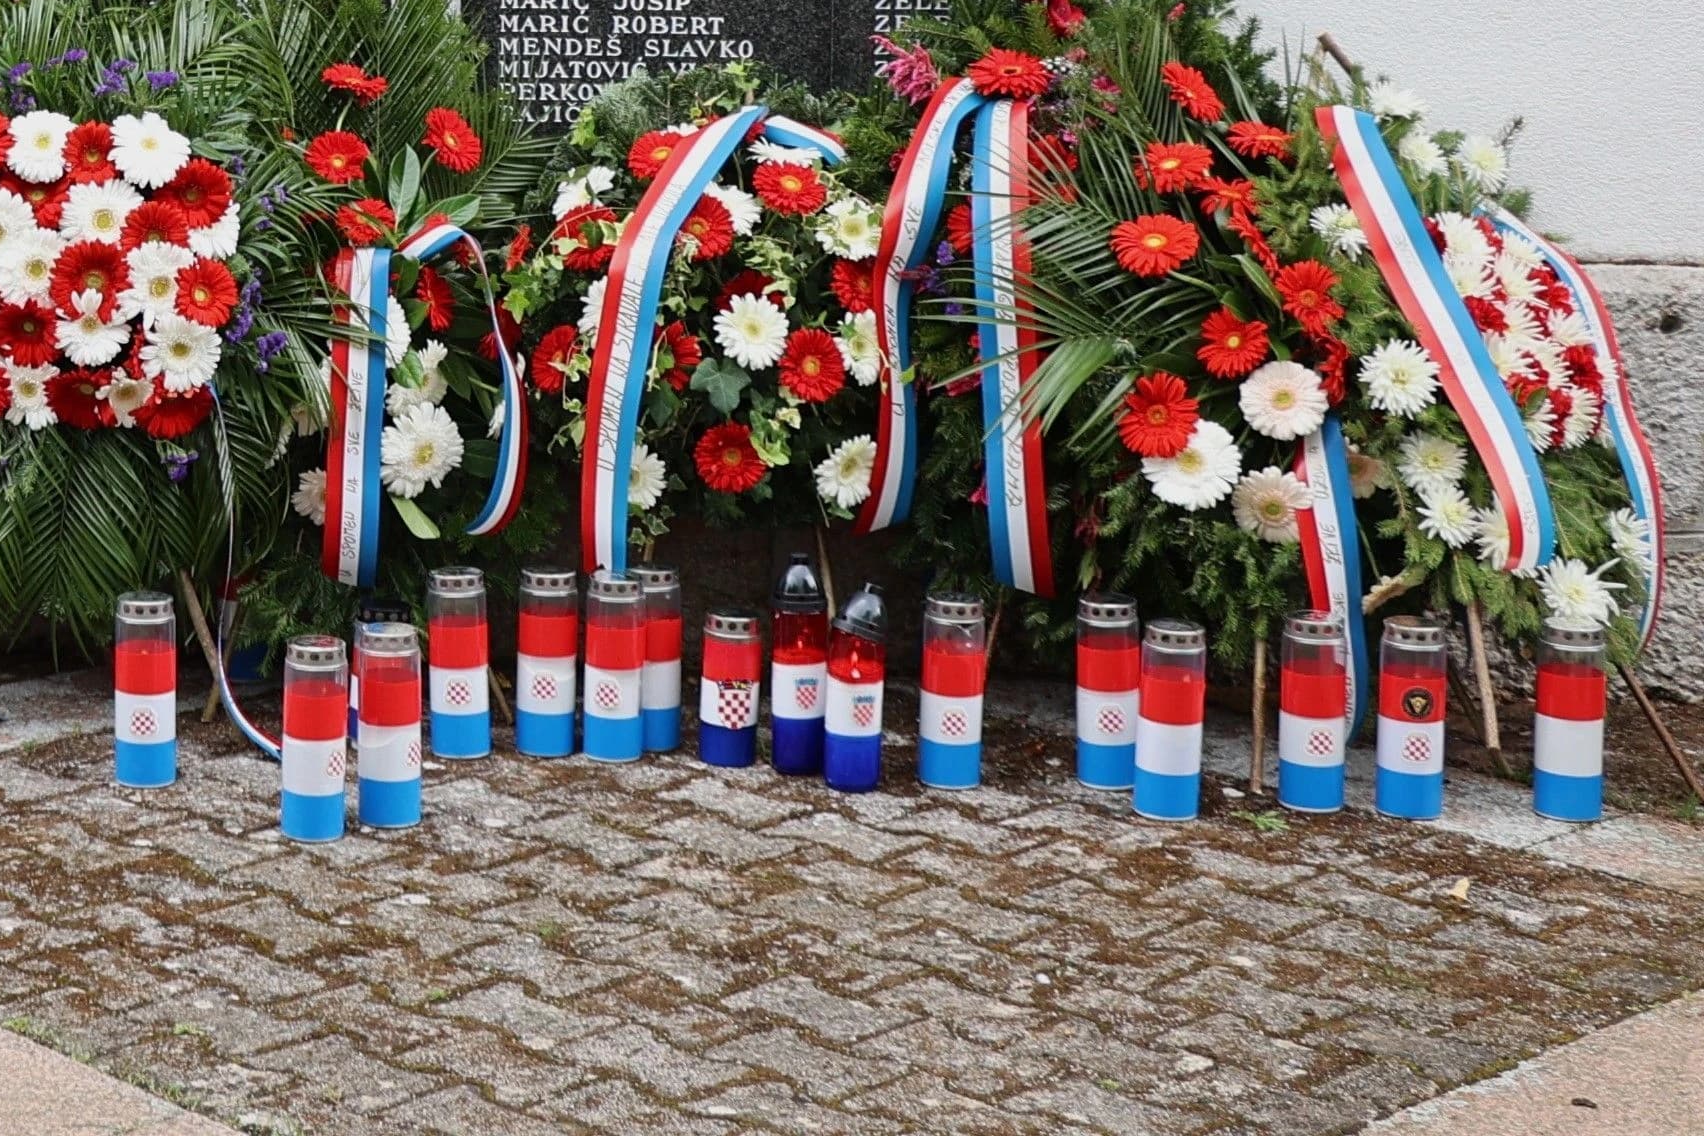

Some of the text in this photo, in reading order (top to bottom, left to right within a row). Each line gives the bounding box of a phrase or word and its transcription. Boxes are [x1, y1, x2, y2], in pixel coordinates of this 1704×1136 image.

[905, 202, 922, 240] SVE
[597, 385, 624, 453] SPOMEN
[346, 431, 361, 456] SVE
[344, 476, 359, 493] NA
[1005, 436, 1024, 509] RAMA
[340, 511, 357, 560] SPOMEN
